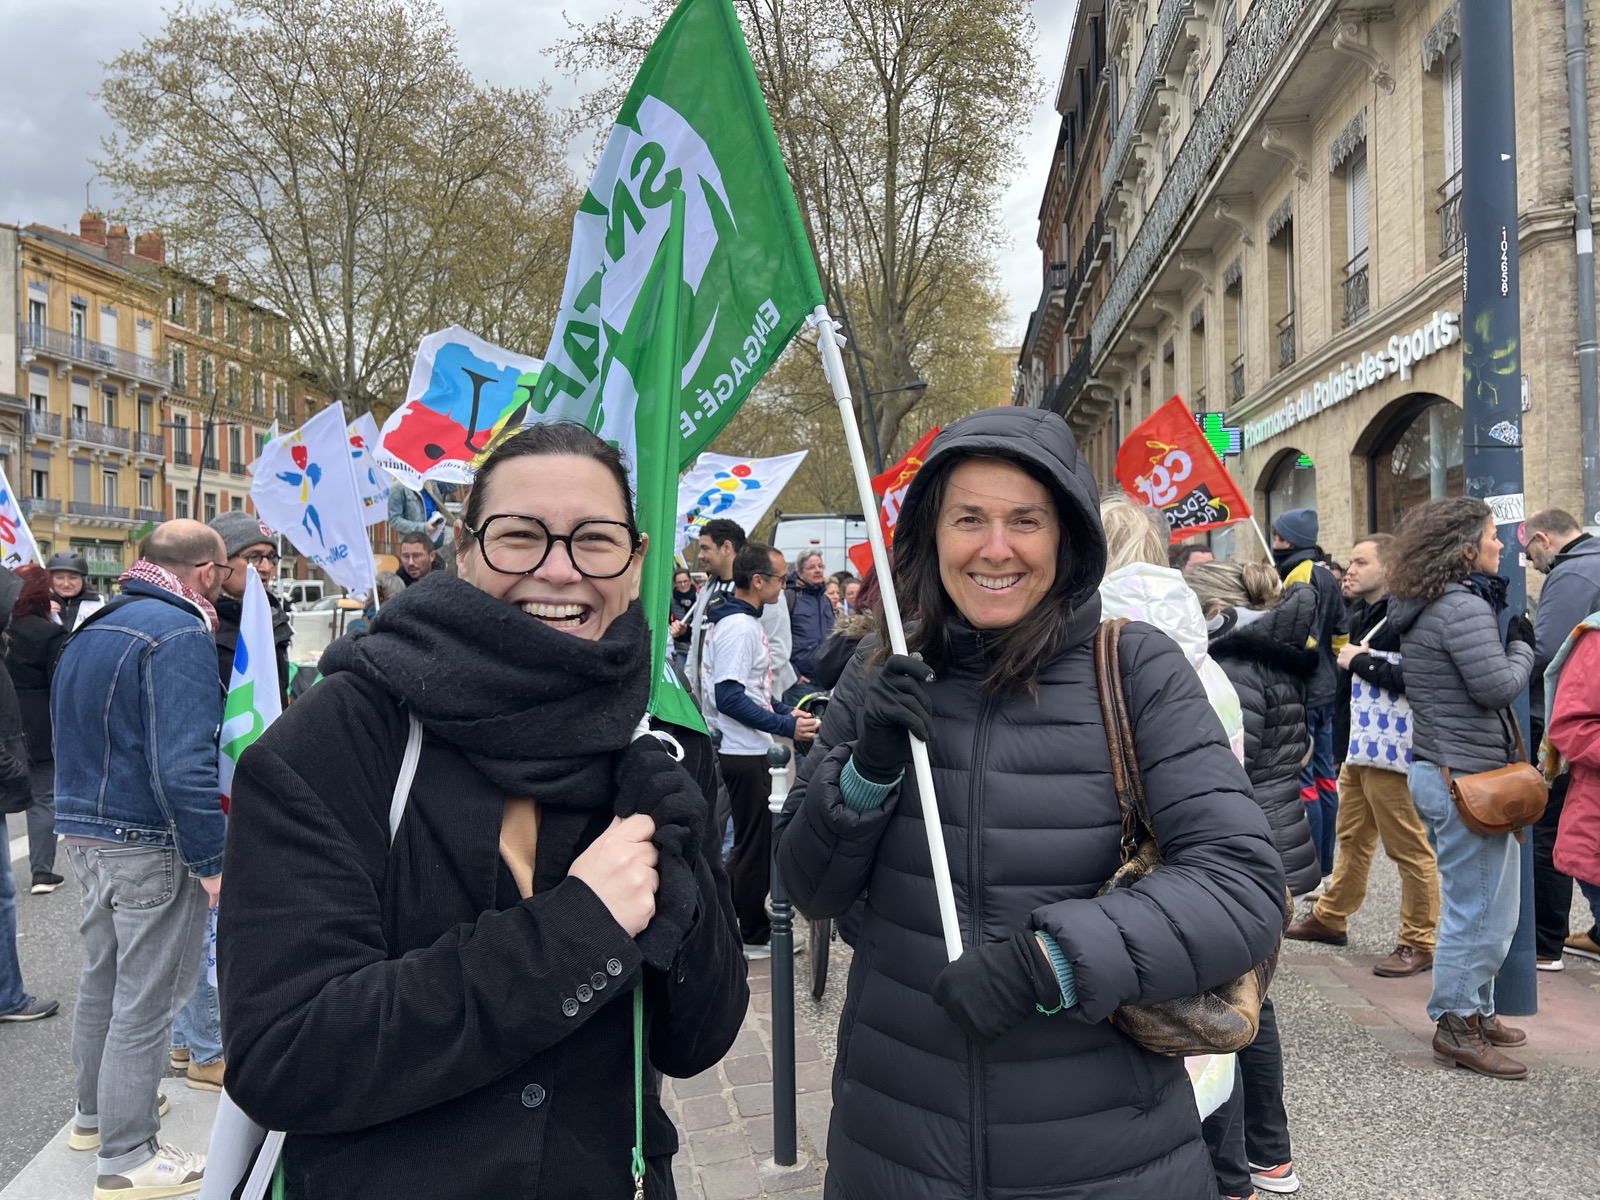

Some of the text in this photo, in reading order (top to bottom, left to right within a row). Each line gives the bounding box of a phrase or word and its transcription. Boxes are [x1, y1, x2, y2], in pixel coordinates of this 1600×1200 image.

[1244, 310, 1461, 449] Pharmacie du Palais des Sports
